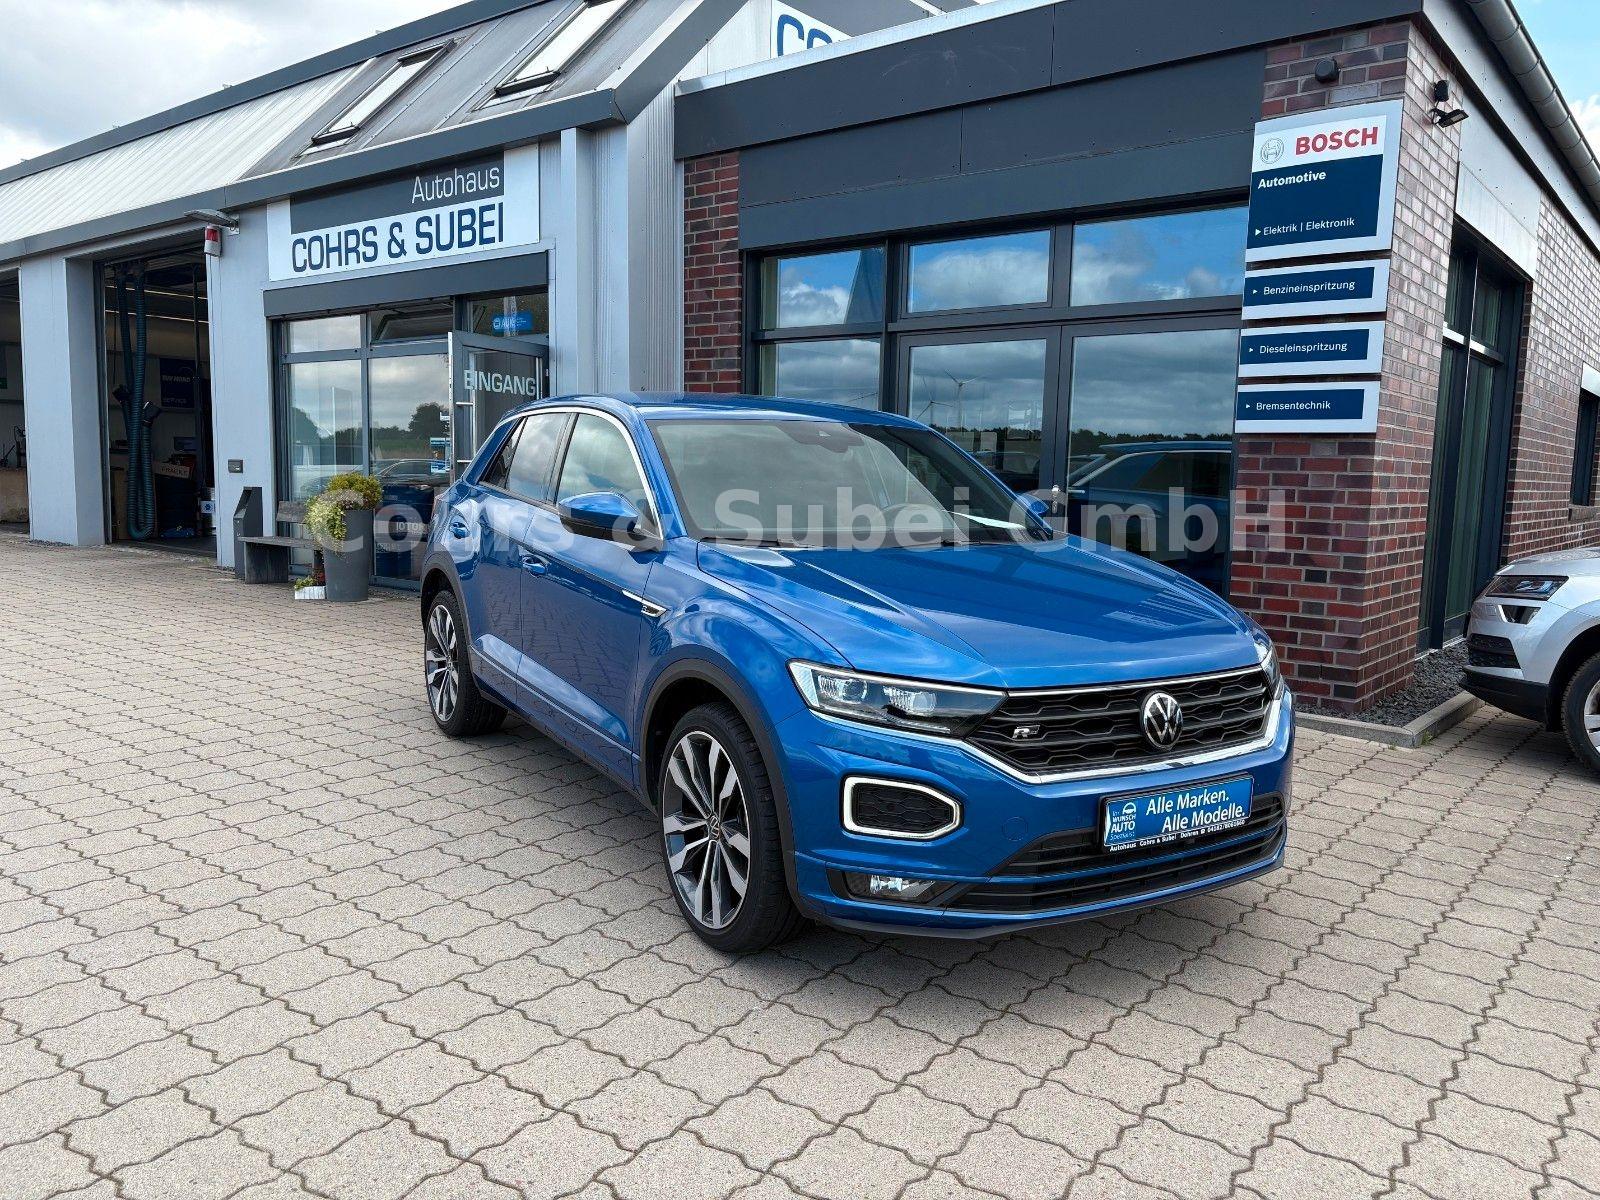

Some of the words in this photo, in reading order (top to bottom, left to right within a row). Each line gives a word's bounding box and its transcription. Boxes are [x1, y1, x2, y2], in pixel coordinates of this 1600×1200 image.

[1295, 126, 1379, 156] BOSCH
[411, 166, 500, 204] Autohaus
[1257, 170, 1327, 190] Automotive
[1263, 223, 1298, 236] Elektrik
[1305, 217, 1355, 231] Elektronik
[291, 225, 378, 273] COHRS
[387, 221, 408, 258] &
[415, 202, 504, 255] SUBEI
[1263, 281, 1356, 296] Benzineinspritzung
[1259, 342, 1348, 355] Dieseleinspritzung
[464, 368, 537, 396] EINGANG
[1256, 400, 1331, 411] Bremsentechnik
[1146, 796, 1173, 816] Alle
[1176, 788, 1230, 811] Marken.
[1110, 820, 1136, 834] AUTO
[1112, 813, 1137, 823] WUNSCH
[1161, 815, 1188, 833] Alle
[1191, 804, 1245, 828] Modelle.
[1109, 842, 1137, 852] Autohaus
